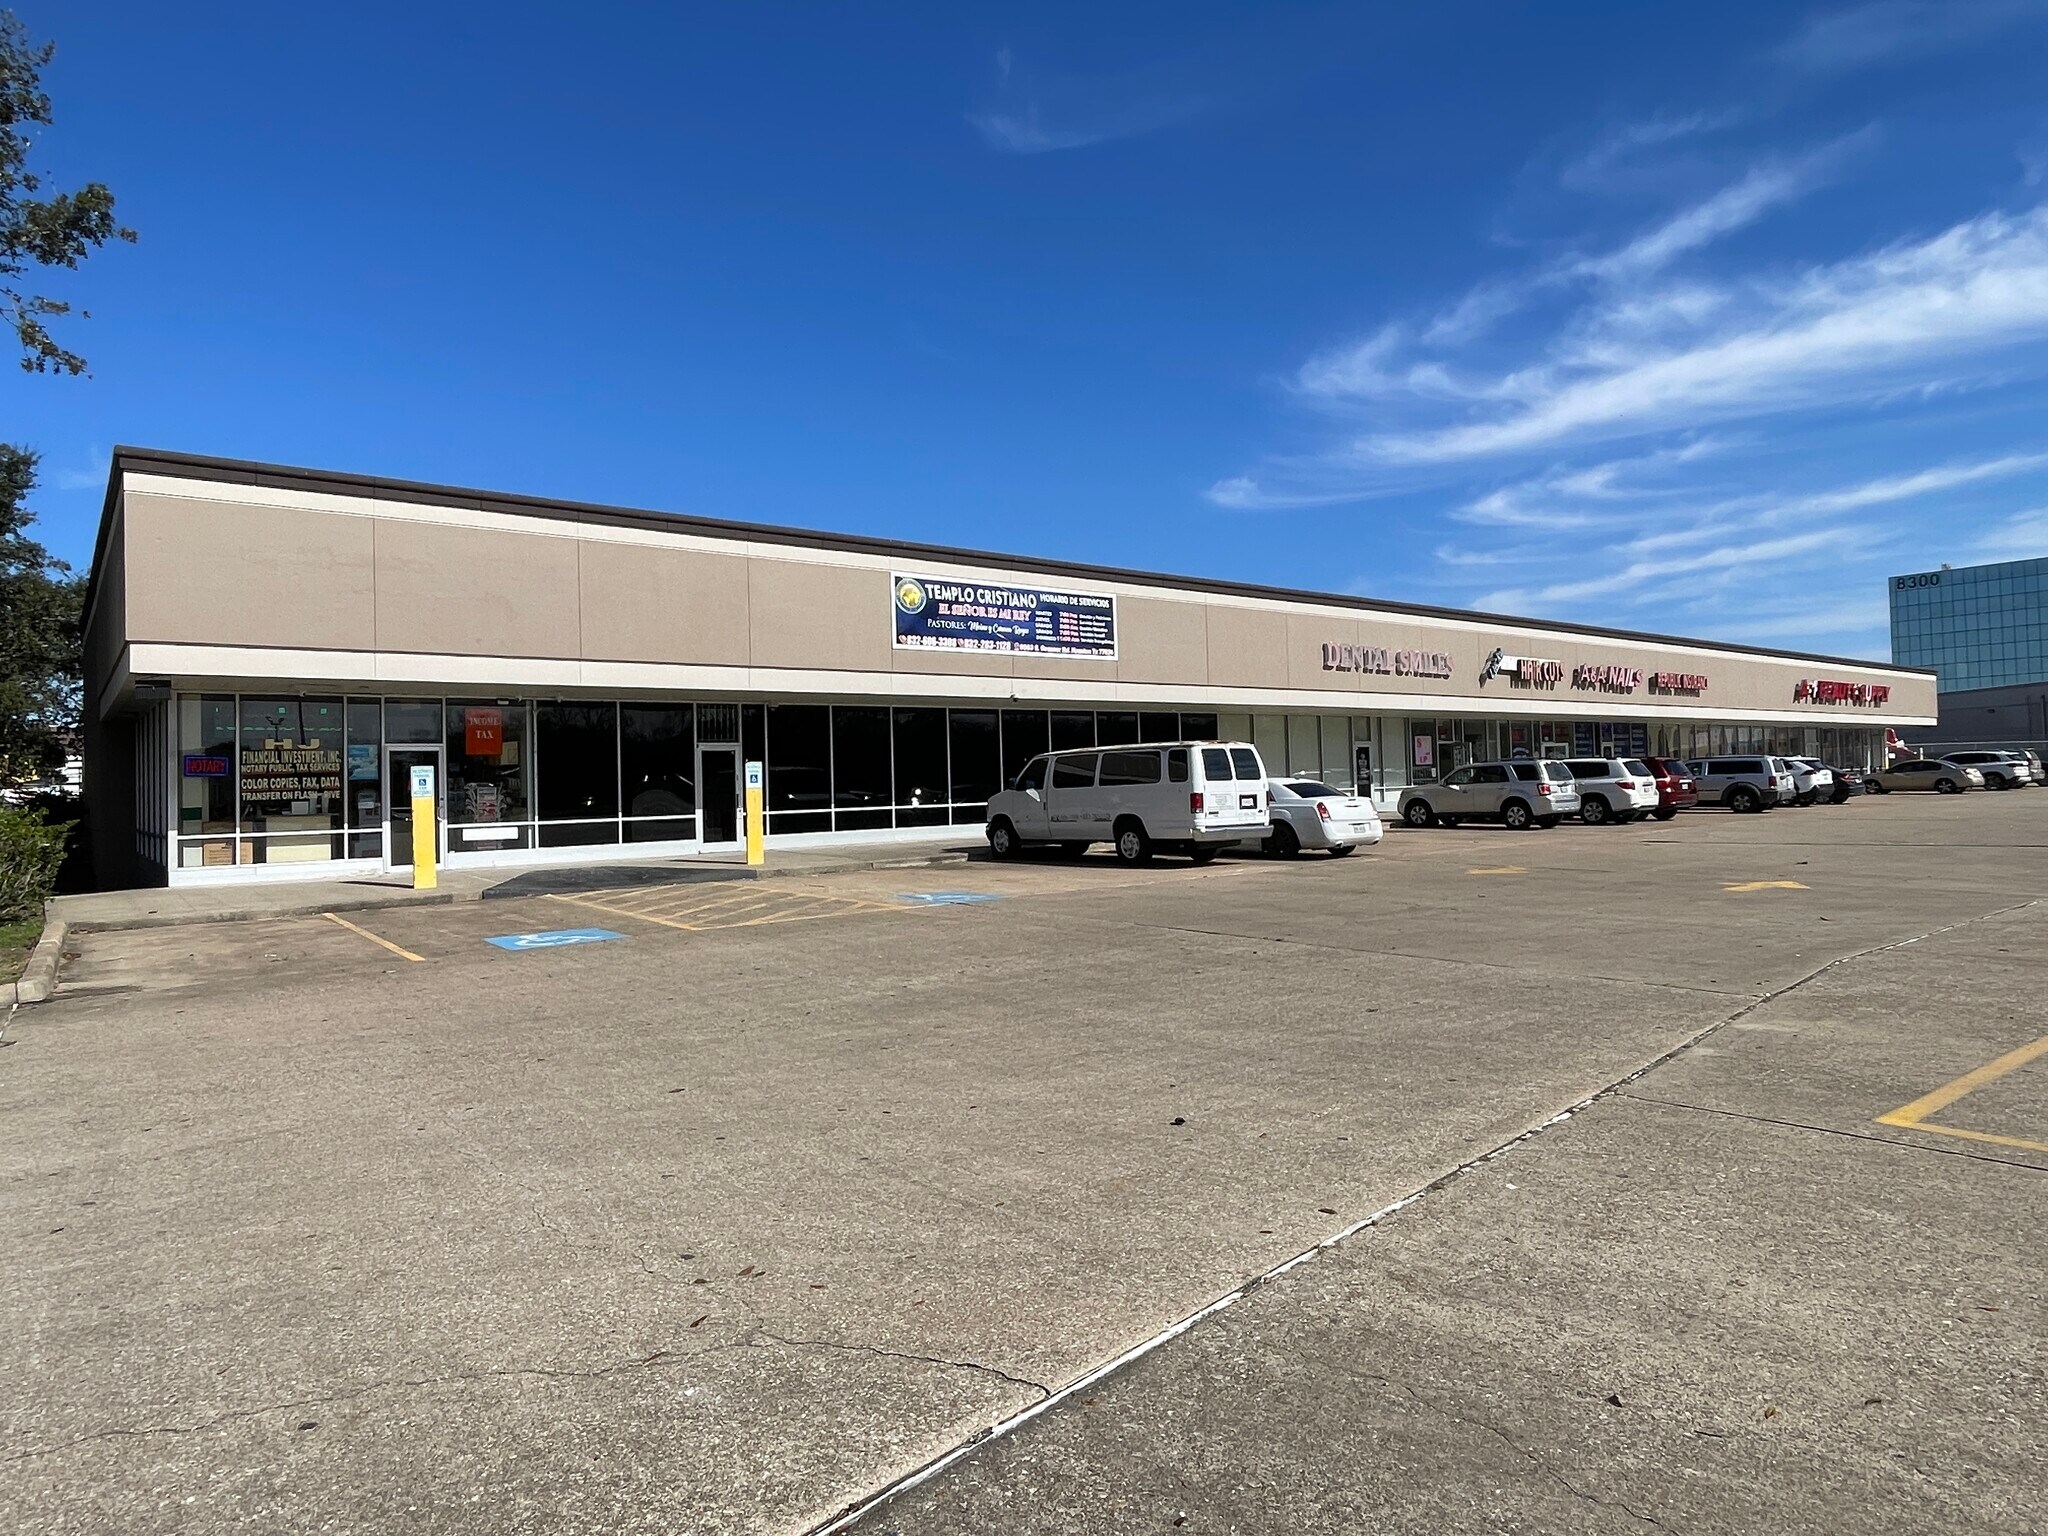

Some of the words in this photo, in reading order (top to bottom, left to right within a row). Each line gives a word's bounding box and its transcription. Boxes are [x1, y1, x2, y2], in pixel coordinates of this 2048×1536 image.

[1896, 574, 1940, 590] 8300
[924, 584, 975, 603] TEMPLO
[976, 589, 1037, 609] CRISTIANO
[1039, 593, 1068, 605] HORARIO
[1069, 598, 1078, 606] DE
[1078, 598, 1110, 609] SERVICIOS
[938, 603, 950, 614] EL
[951, 603, 987, 618] SEÑOR
[987, 608, 998, 618] ES
[998, 609, 1012, 620] MI
[1012, 610, 1032, 622] REY
[927, 618, 967, 630] PASTORES:
[1325, 641, 1394, 672] DENTAL
[1398, 649, 1456, 676] SMILES
[1519, 659, 1543, 681] HAIR
[1543, 661, 1565, 682] CUTS
[1579, 664, 1606, 684] A&A
[1608, 666, 1644, 689] NAILS
[469, 717, 499, 726] INCOME
[475, 730, 494, 739] TAX
[242, 751, 280, 764] FINANCIAL
[327, 750, 342, 763] INC.
[187, 760, 225, 773] NOTARY
[241, 764, 268, 773] NOTARY
[268, 763, 295, 774] PUBLIC,
[295, 763, 309, 772] TAX
[309, 763, 340, 772] SERVICES
[241, 778, 269, 790] COLOR
[270, 777, 301, 790] COPIES,
[302, 776, 320, 790] FAX,
[320, 776, 340, 788] DATA
[242, 791, 281, 801] TRANSFER
[281, 791, 294, 800] ON
[294, 790, 317, 800] FLASH
